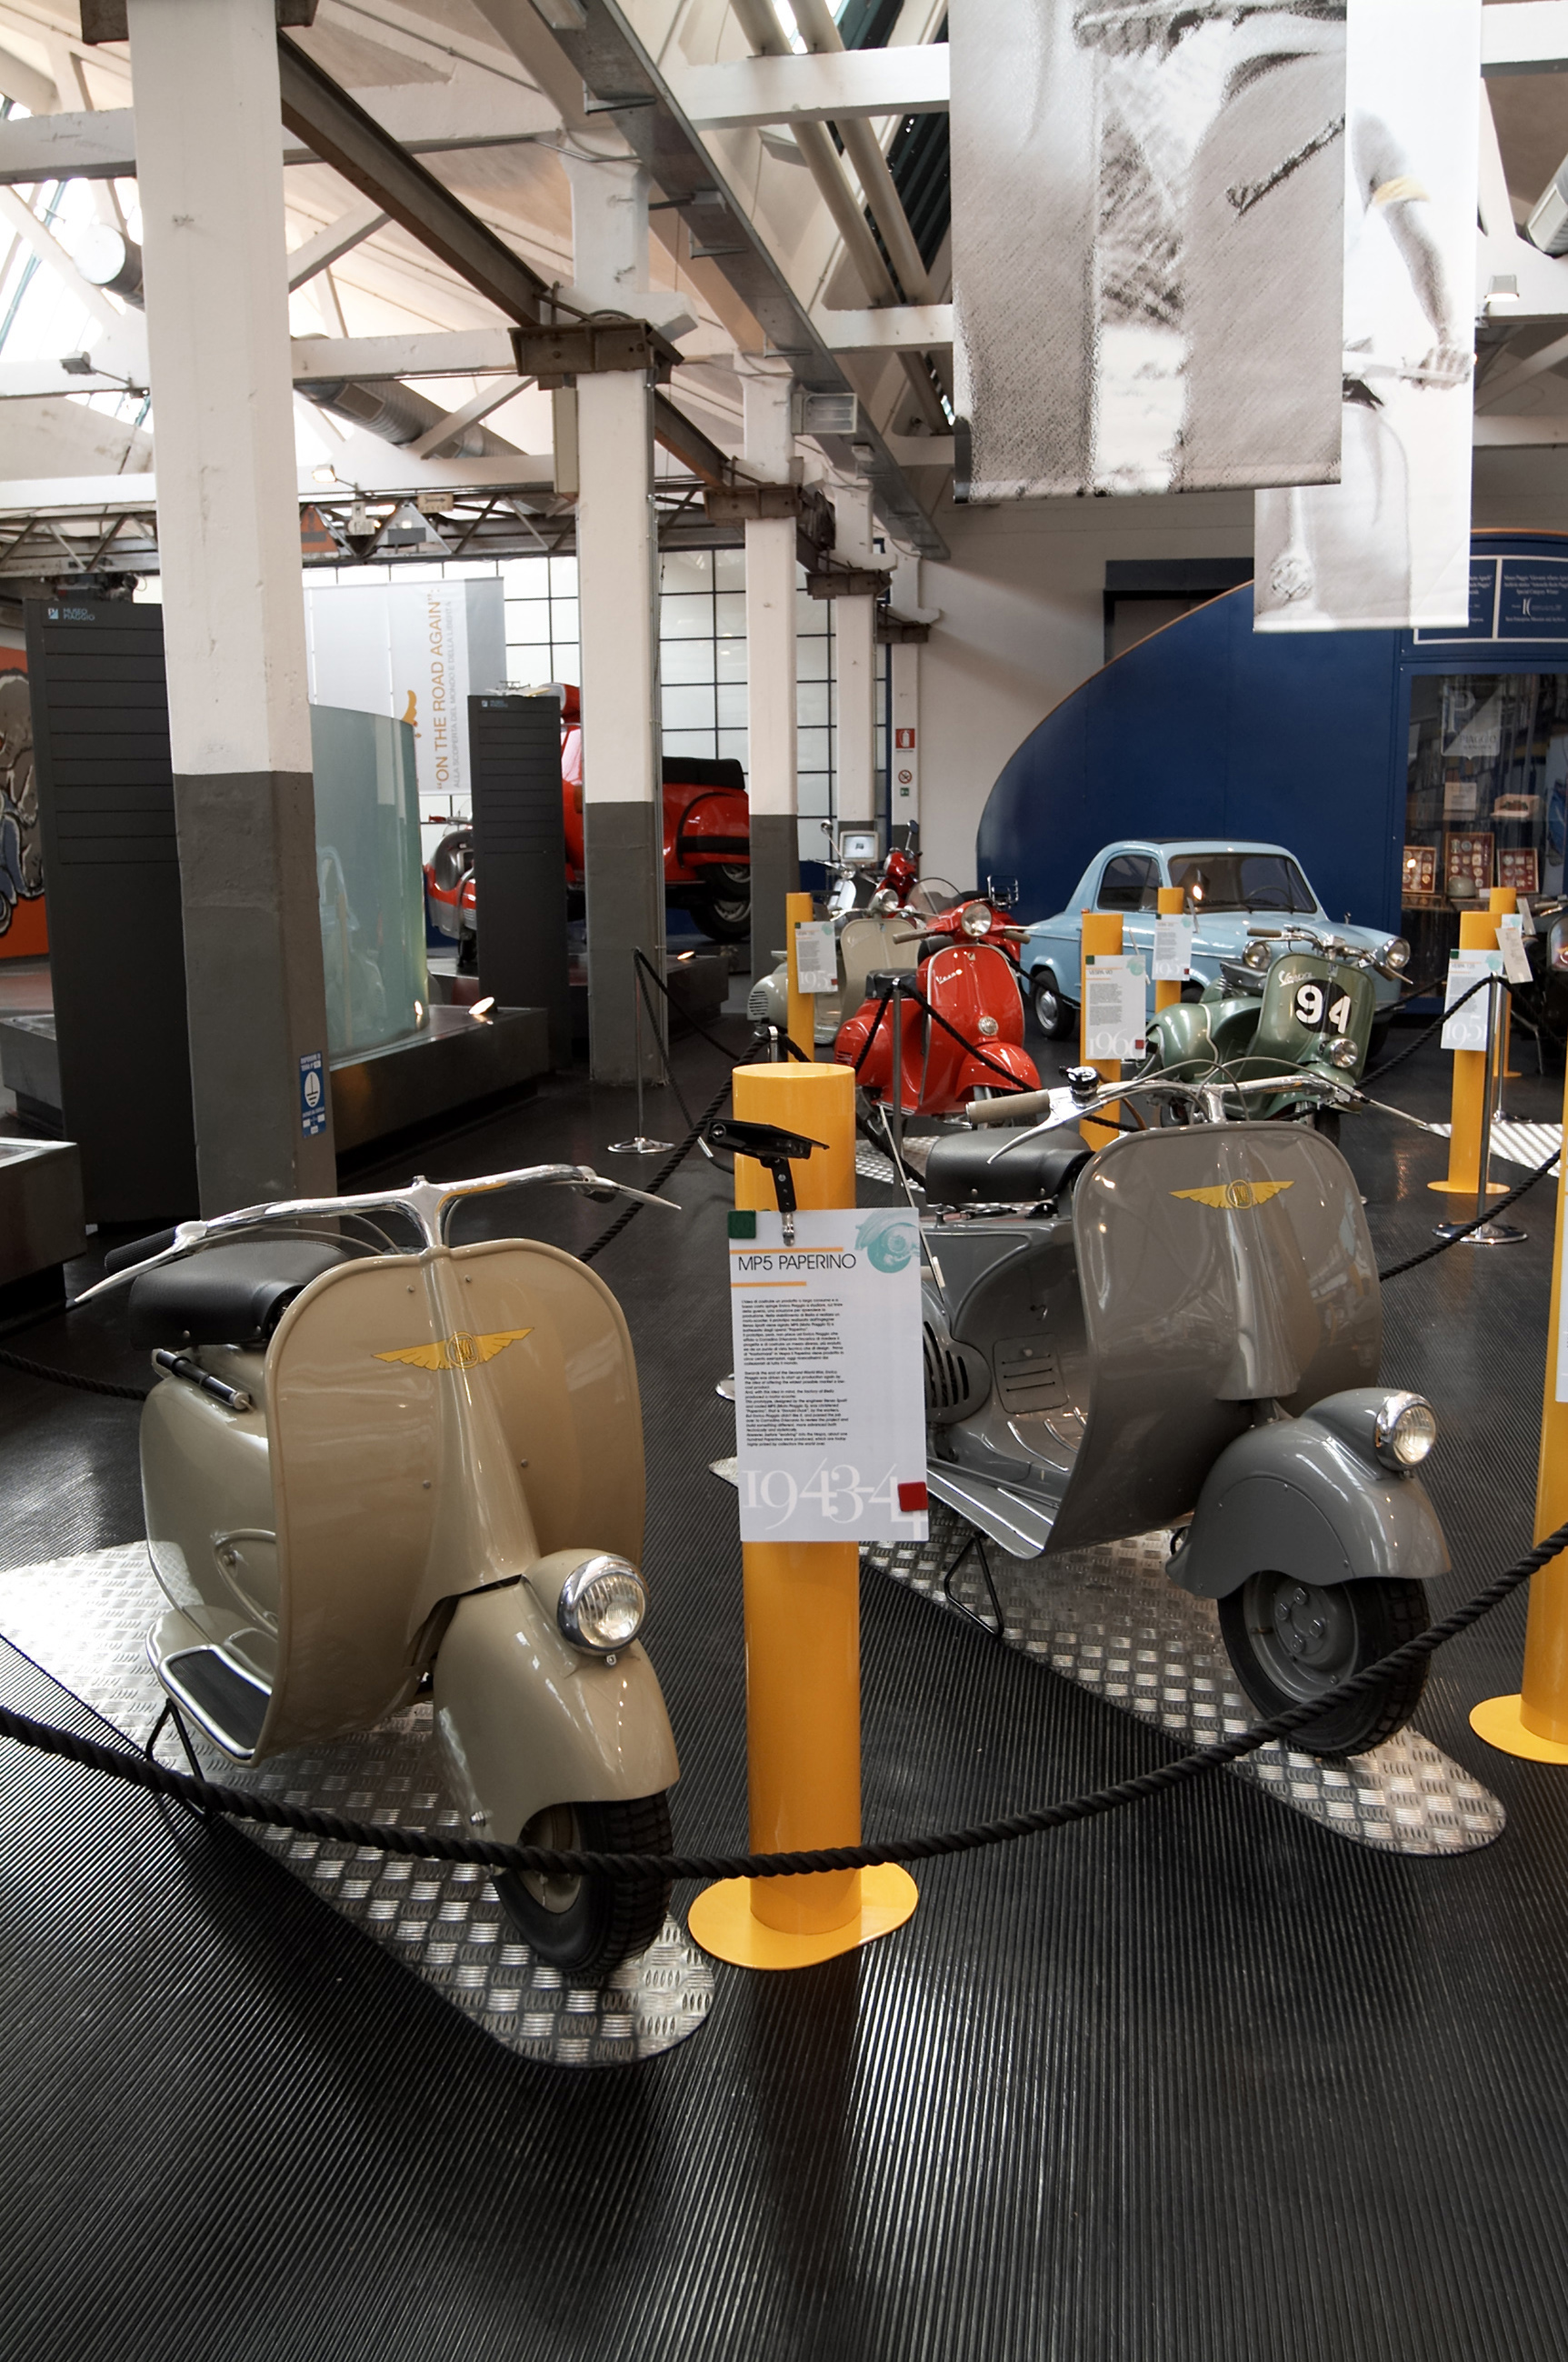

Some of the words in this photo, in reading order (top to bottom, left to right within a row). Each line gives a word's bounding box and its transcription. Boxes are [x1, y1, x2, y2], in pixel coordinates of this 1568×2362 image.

[431, 661, 445, 712] ROAD
[434, 716, 447, 751] THE
[1295, 985, 1351, 1034] 94
[738, 1256, 774, 1271] MP5
[778, 1253, 857, 1270] PAPERINO
